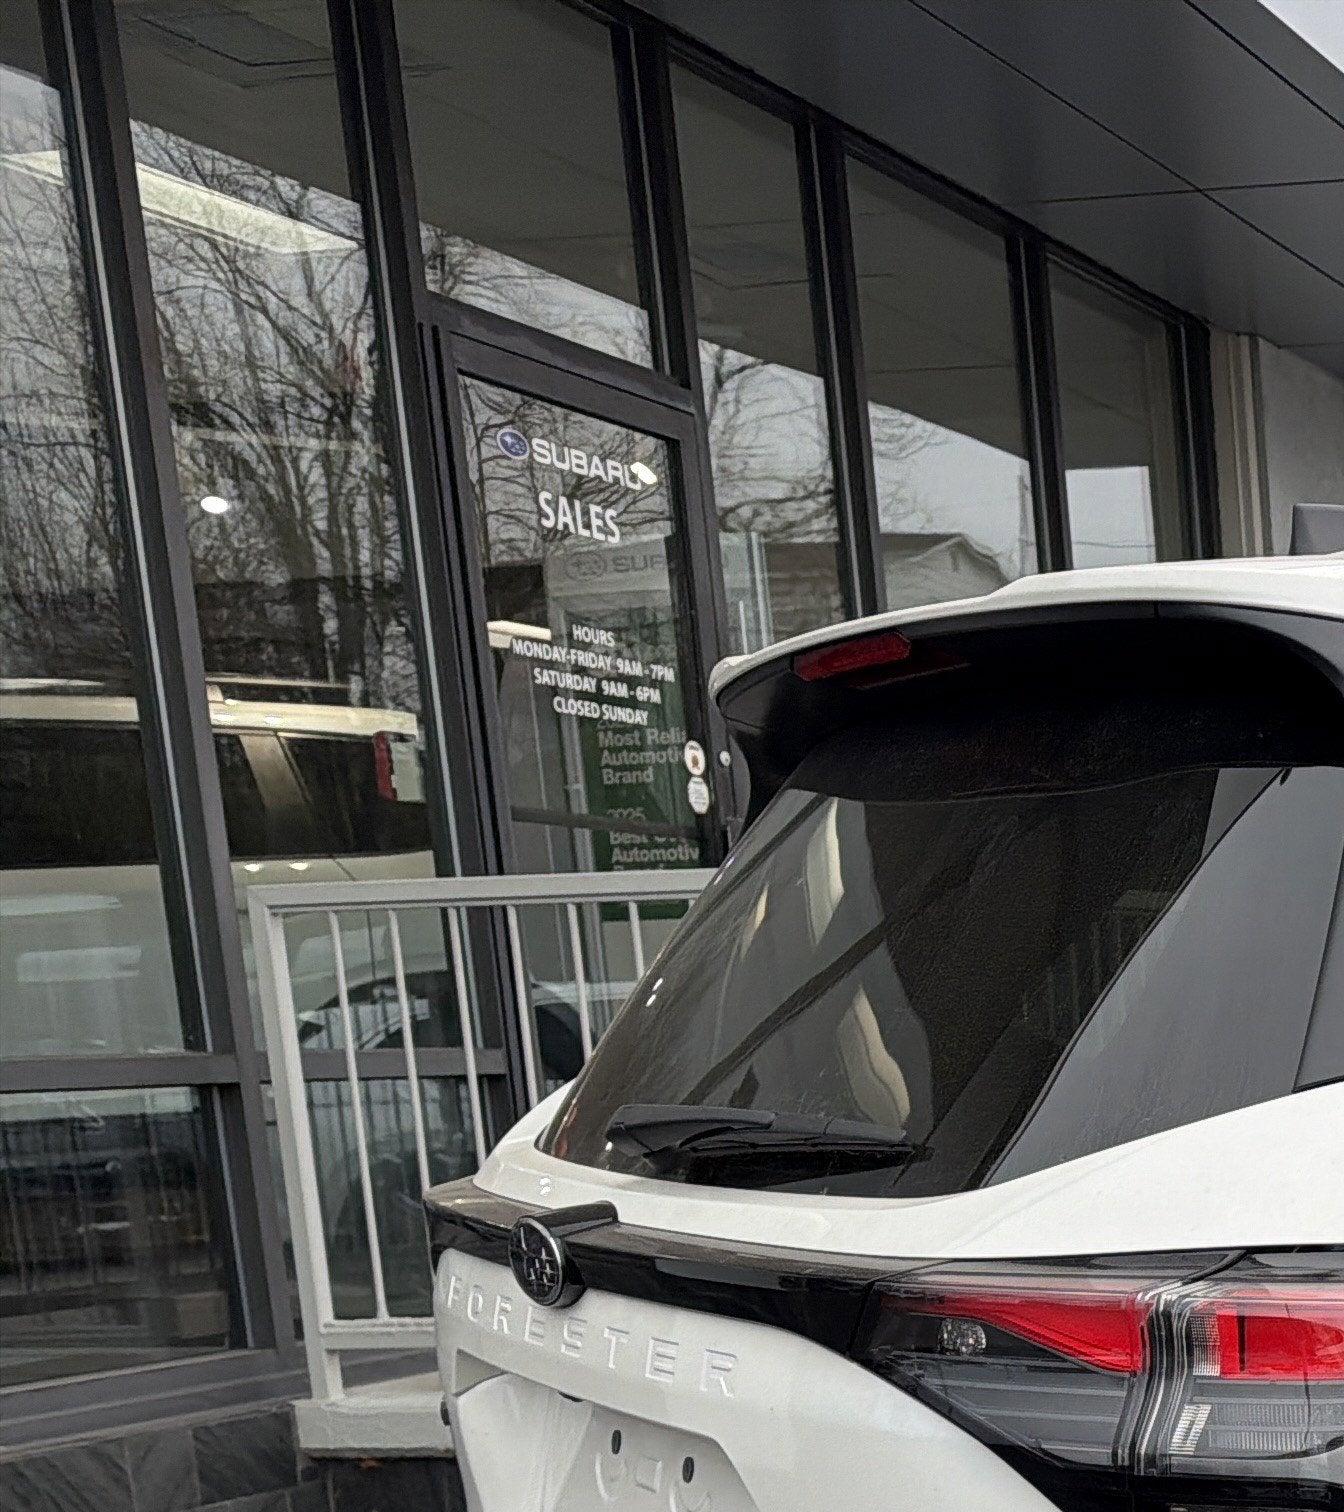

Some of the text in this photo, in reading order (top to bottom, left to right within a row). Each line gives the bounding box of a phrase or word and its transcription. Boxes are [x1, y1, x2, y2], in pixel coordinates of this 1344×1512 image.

[530, 437, 642, 491] SUBARU
[537, 490, 621, 544] SALES
[571, 623, 616, 648] HOURS
[511, 638, 612, 672] MONDAY-FRIDAY
[533, 667, 597, 693] SATURDAY
[553, 695, 649, 726] CLOSED SUNDAY
[597, 729, 641, 748] Most
[602, 766, 655, 785] Brand
[446, 1274, 739, 1398] FORESTER
